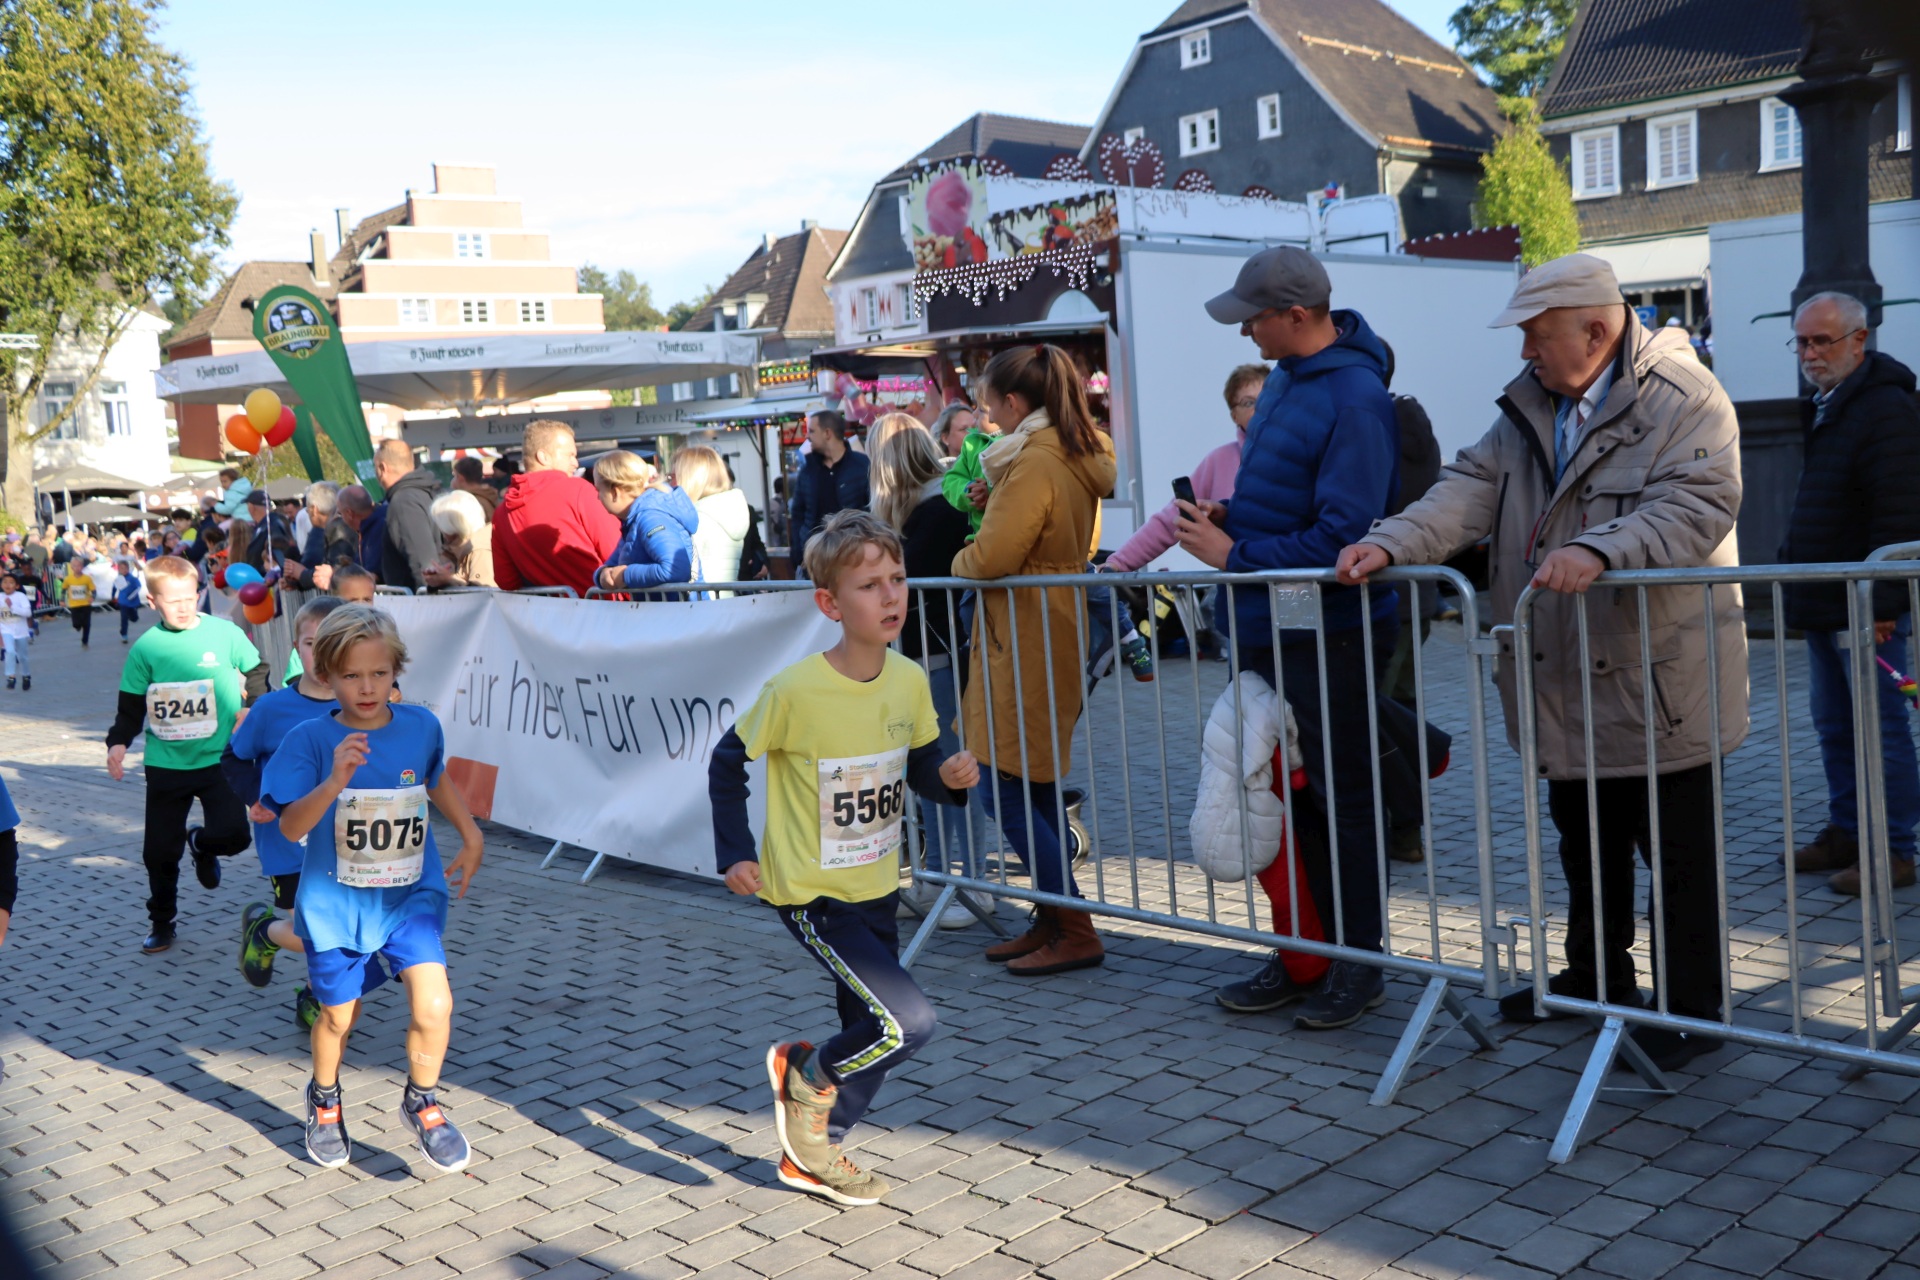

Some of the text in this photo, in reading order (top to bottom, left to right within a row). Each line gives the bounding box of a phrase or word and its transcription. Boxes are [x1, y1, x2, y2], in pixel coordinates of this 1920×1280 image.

[453, 656, 499, 728] Für
[154, 697, 209, 720] 5244
[833, 779, 902, 827] 5568
[346, 816, 424, 851] 5075
[828, 857, 846, 865] AOK
[856, 851, 878, 862] VOSS
[342, 875, 357, 883] AOK
[367, 877, 391, 885] VOSS
